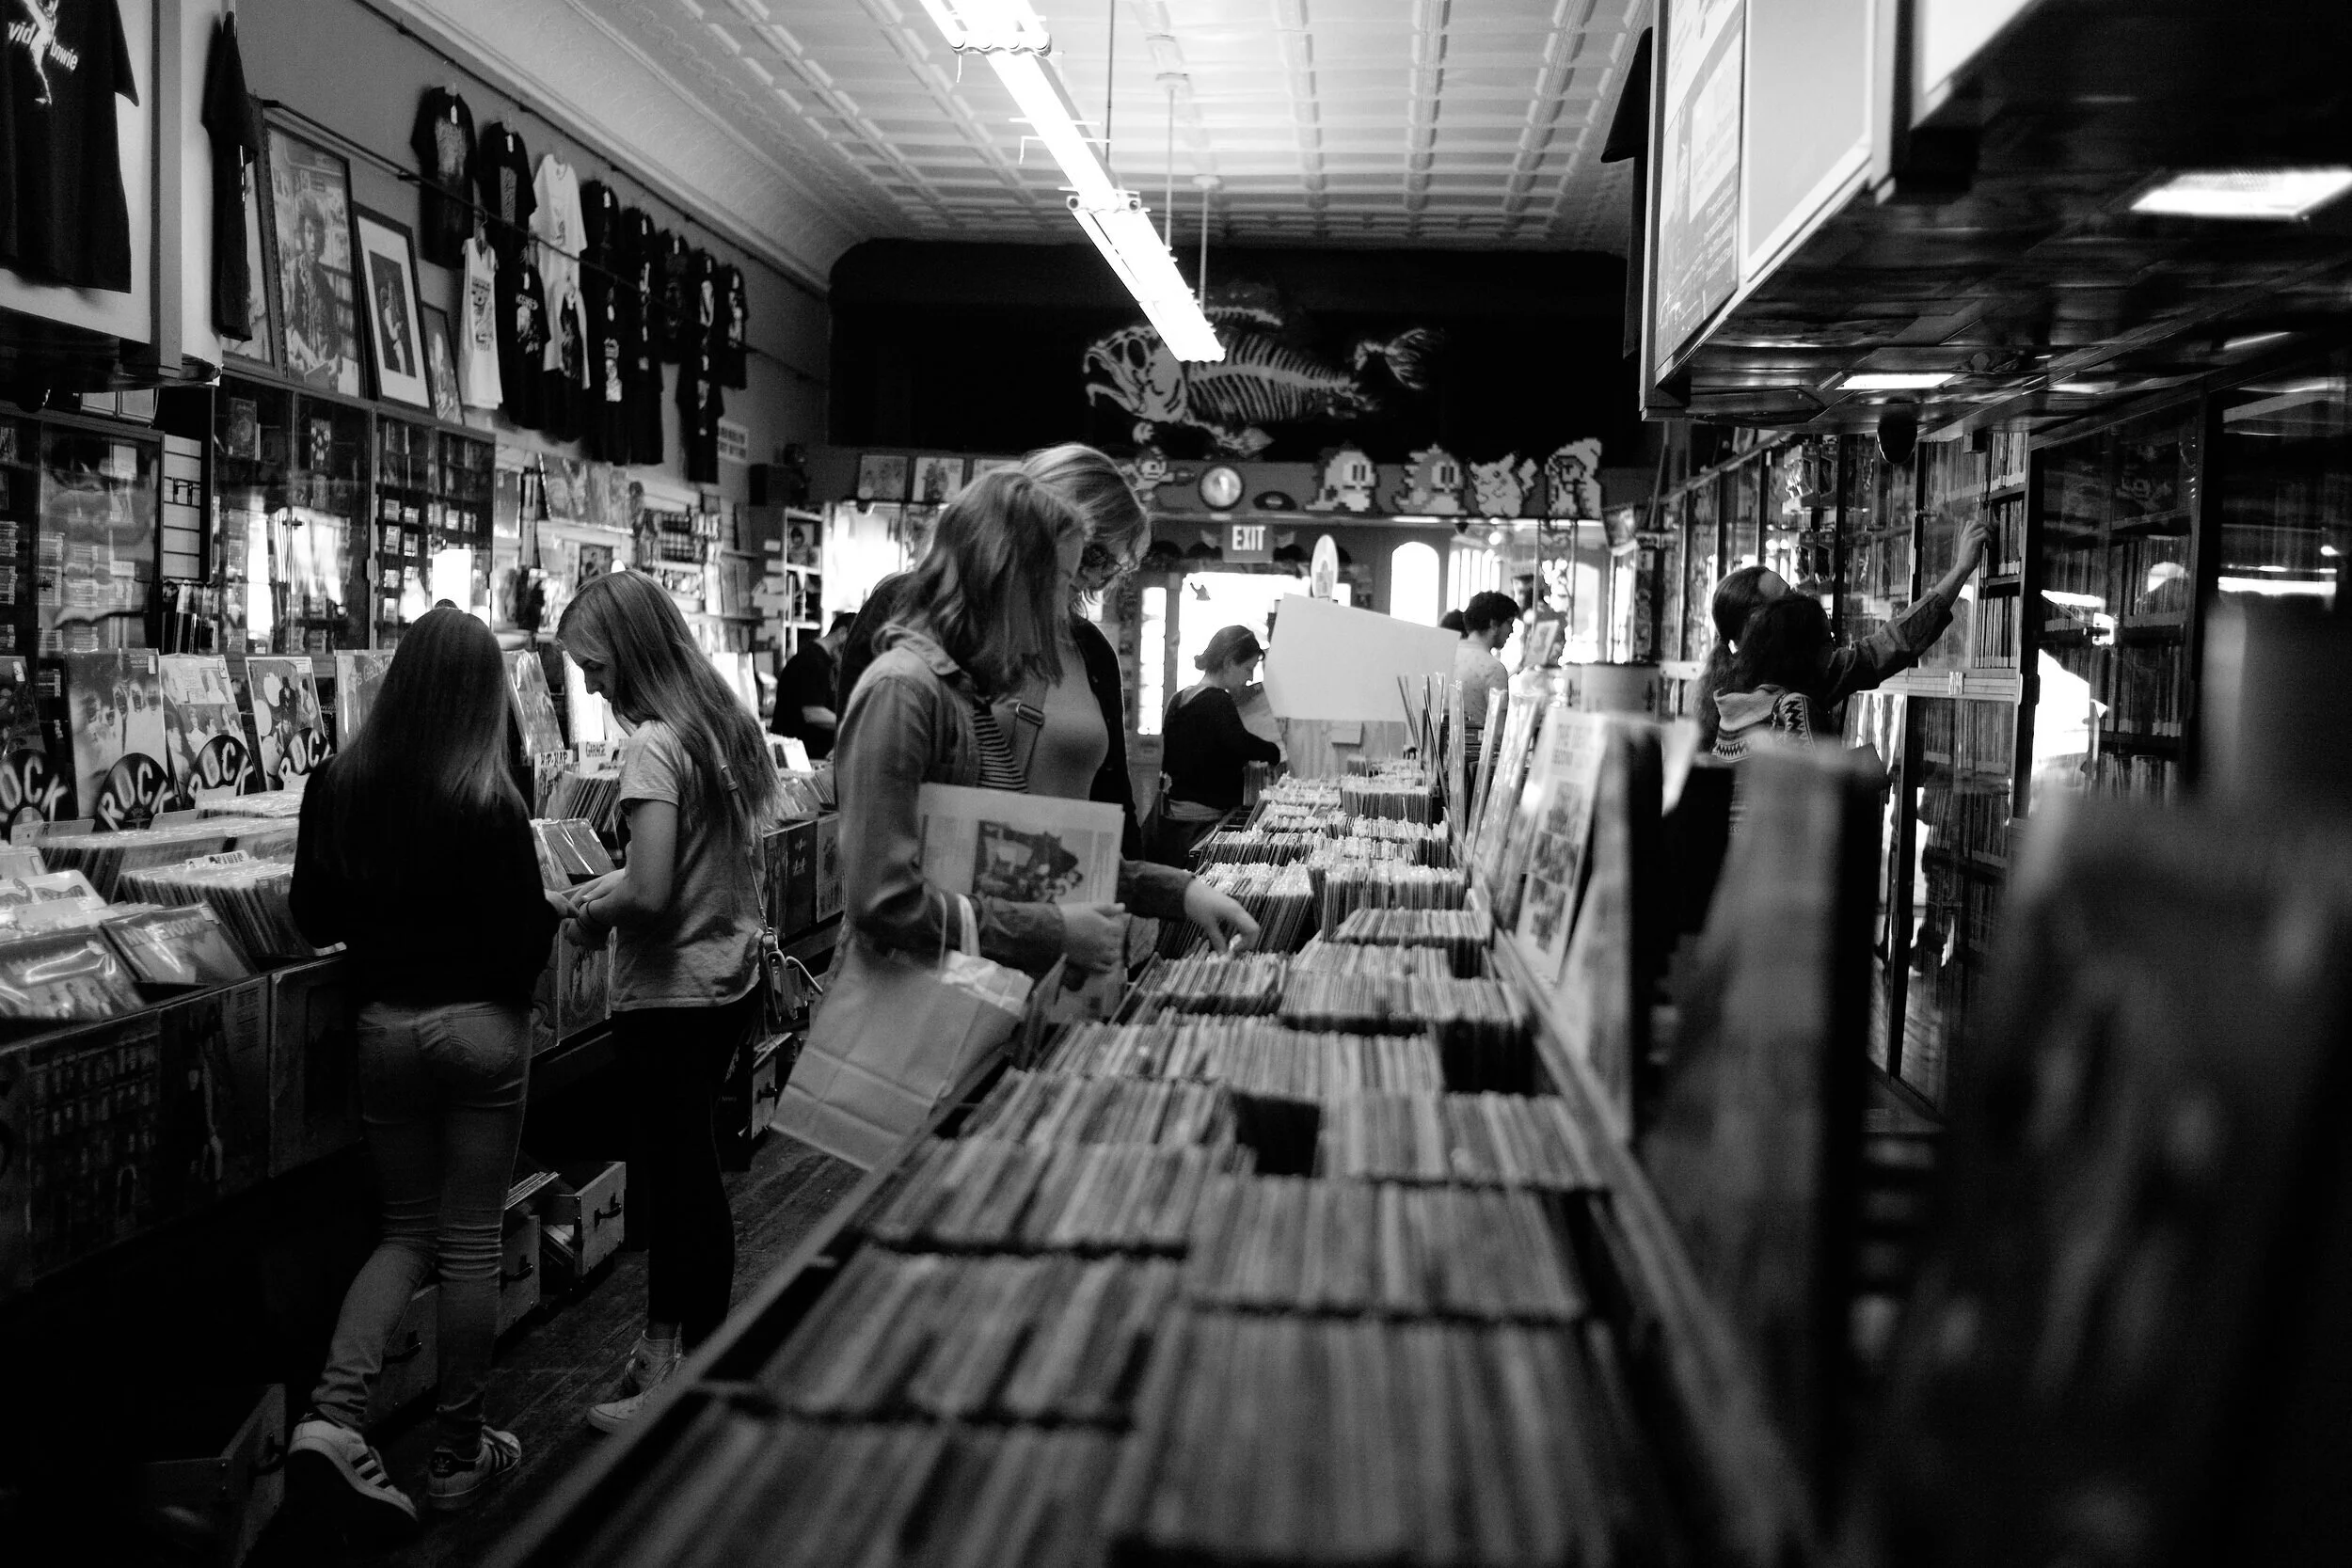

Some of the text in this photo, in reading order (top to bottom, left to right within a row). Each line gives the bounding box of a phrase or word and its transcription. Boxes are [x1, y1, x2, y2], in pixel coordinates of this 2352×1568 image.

[50, 36, 79, 71] bowie
[1232, 525, 1266, 551] EXIT
[0, 755, 68, 822] OCK
[98, 763, 175, 832] ROCK
